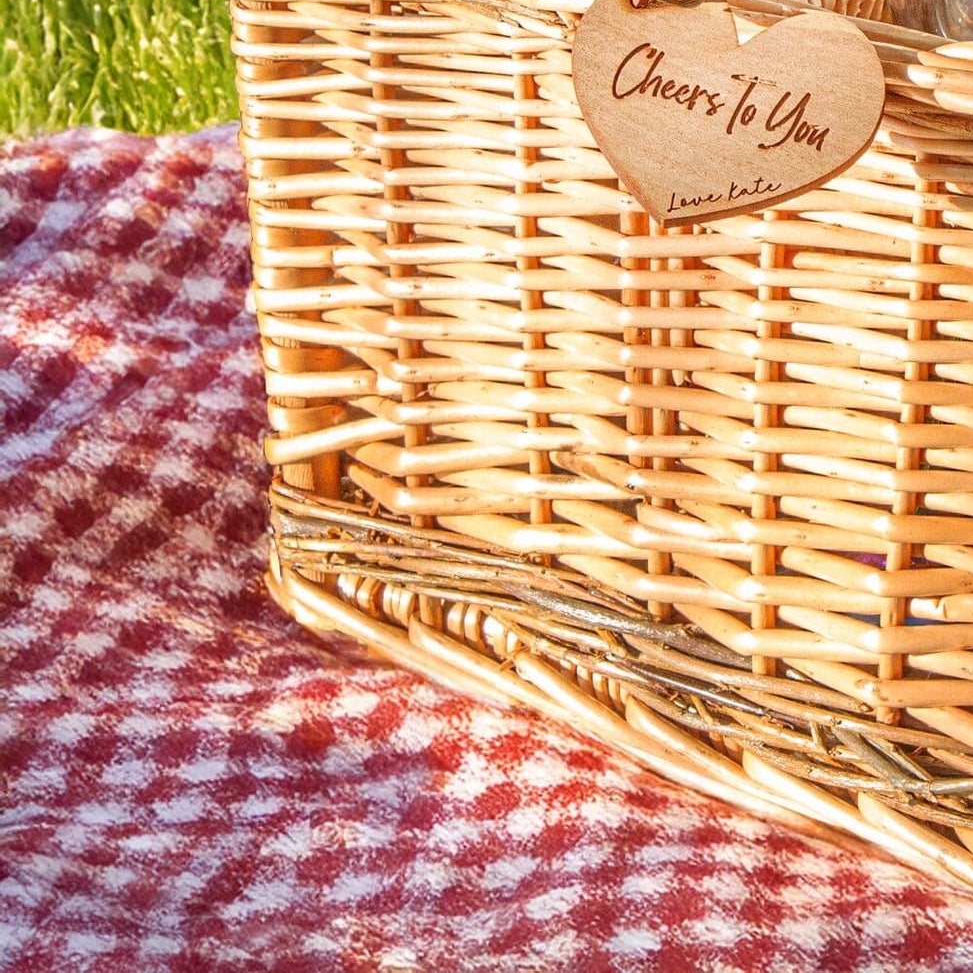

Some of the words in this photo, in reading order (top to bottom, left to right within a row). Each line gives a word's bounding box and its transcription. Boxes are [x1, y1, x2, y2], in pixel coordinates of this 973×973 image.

[612, 43, 725, 116] Cheers
[726, 74, 777, 134] To
[758, 91, 830, 151] You
[667, 192, 722, 213] Love
